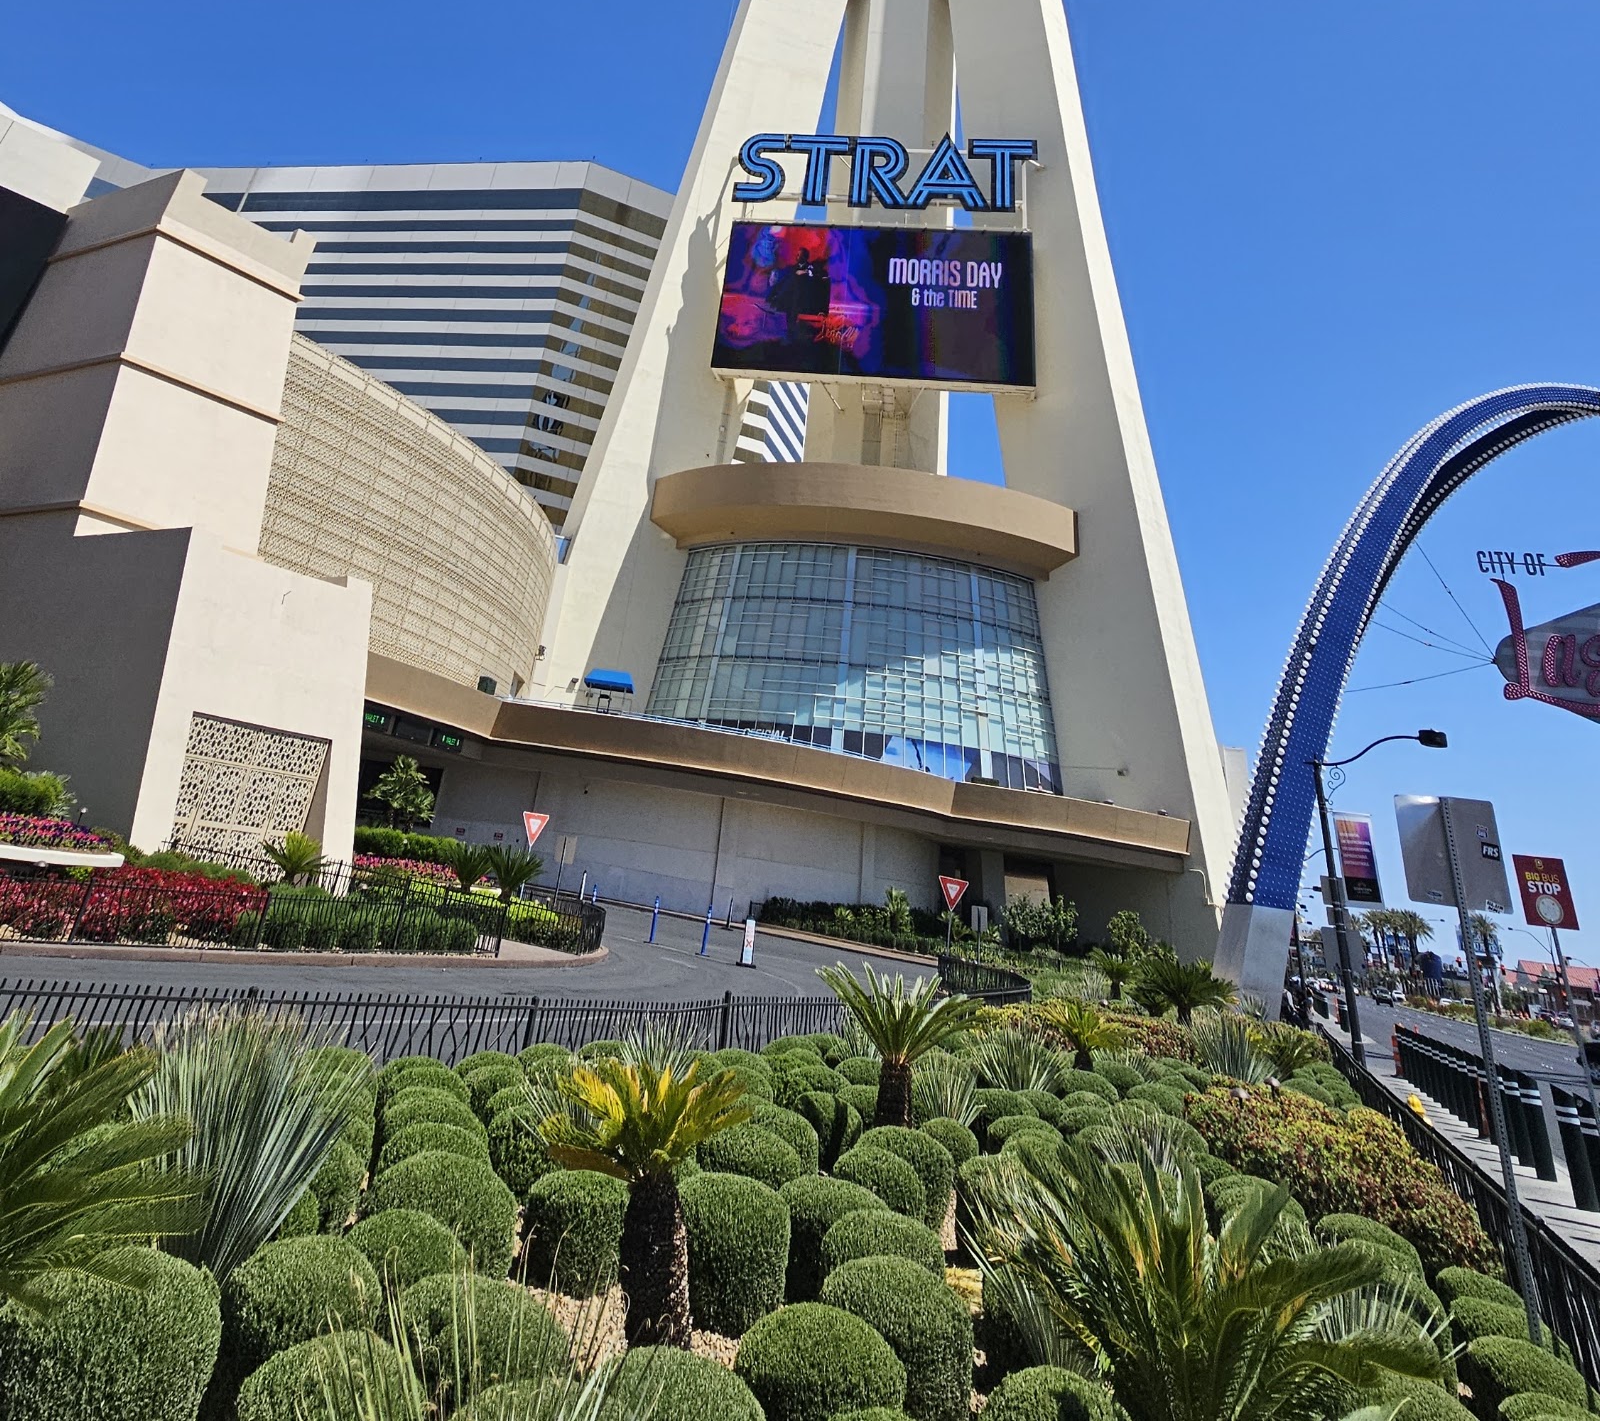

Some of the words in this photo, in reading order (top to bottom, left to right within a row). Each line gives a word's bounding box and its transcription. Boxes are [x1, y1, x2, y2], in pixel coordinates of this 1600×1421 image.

[731, 132, 1038, 212] STRAT
[888, 257, 961, 287] MORRIS
[966, 260, 1002, 289] DAY
[911, 288, 920, 306] &
[924, 289, 945, 307] the
[948, 289, 977, 309] TIME
[1477, 551, 1515, 574] CITY
[1523, 553, 1545, 576] OF
[1482, 845, 1499, 858] FRS
[1525, 871, 1540, 881] BIG
[1542, 873, 1560, 884] BUS
[1527, 880, 1561, 896] STOP
